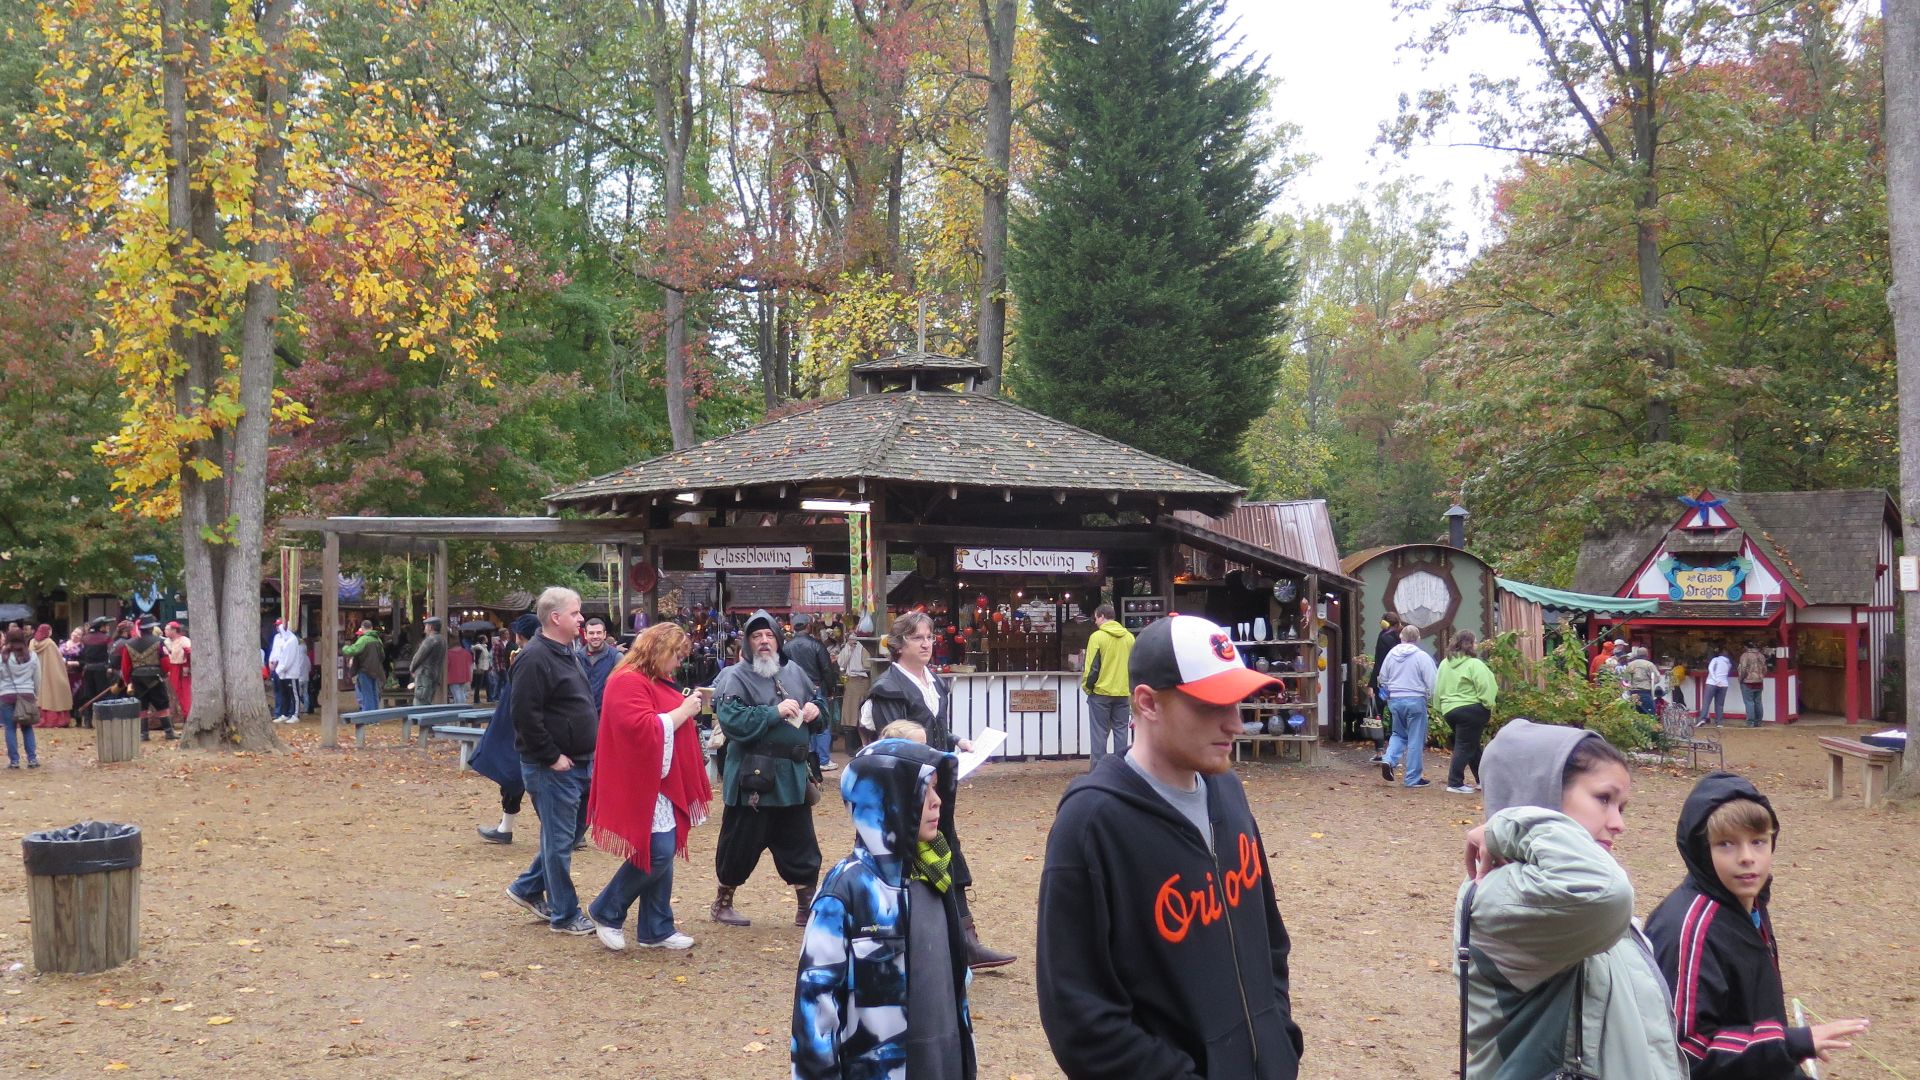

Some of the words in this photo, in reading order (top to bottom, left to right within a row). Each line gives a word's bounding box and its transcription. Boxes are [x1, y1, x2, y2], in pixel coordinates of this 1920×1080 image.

[713, 546, 791, 569] Glassblowing
[974, 548, 1074, 573] Glassblowing
[1697, 573, 1722, 583] Glass
[1686, 584, 1724, 599] Dragon
[1155, 832, 1262, 943] Oriol
